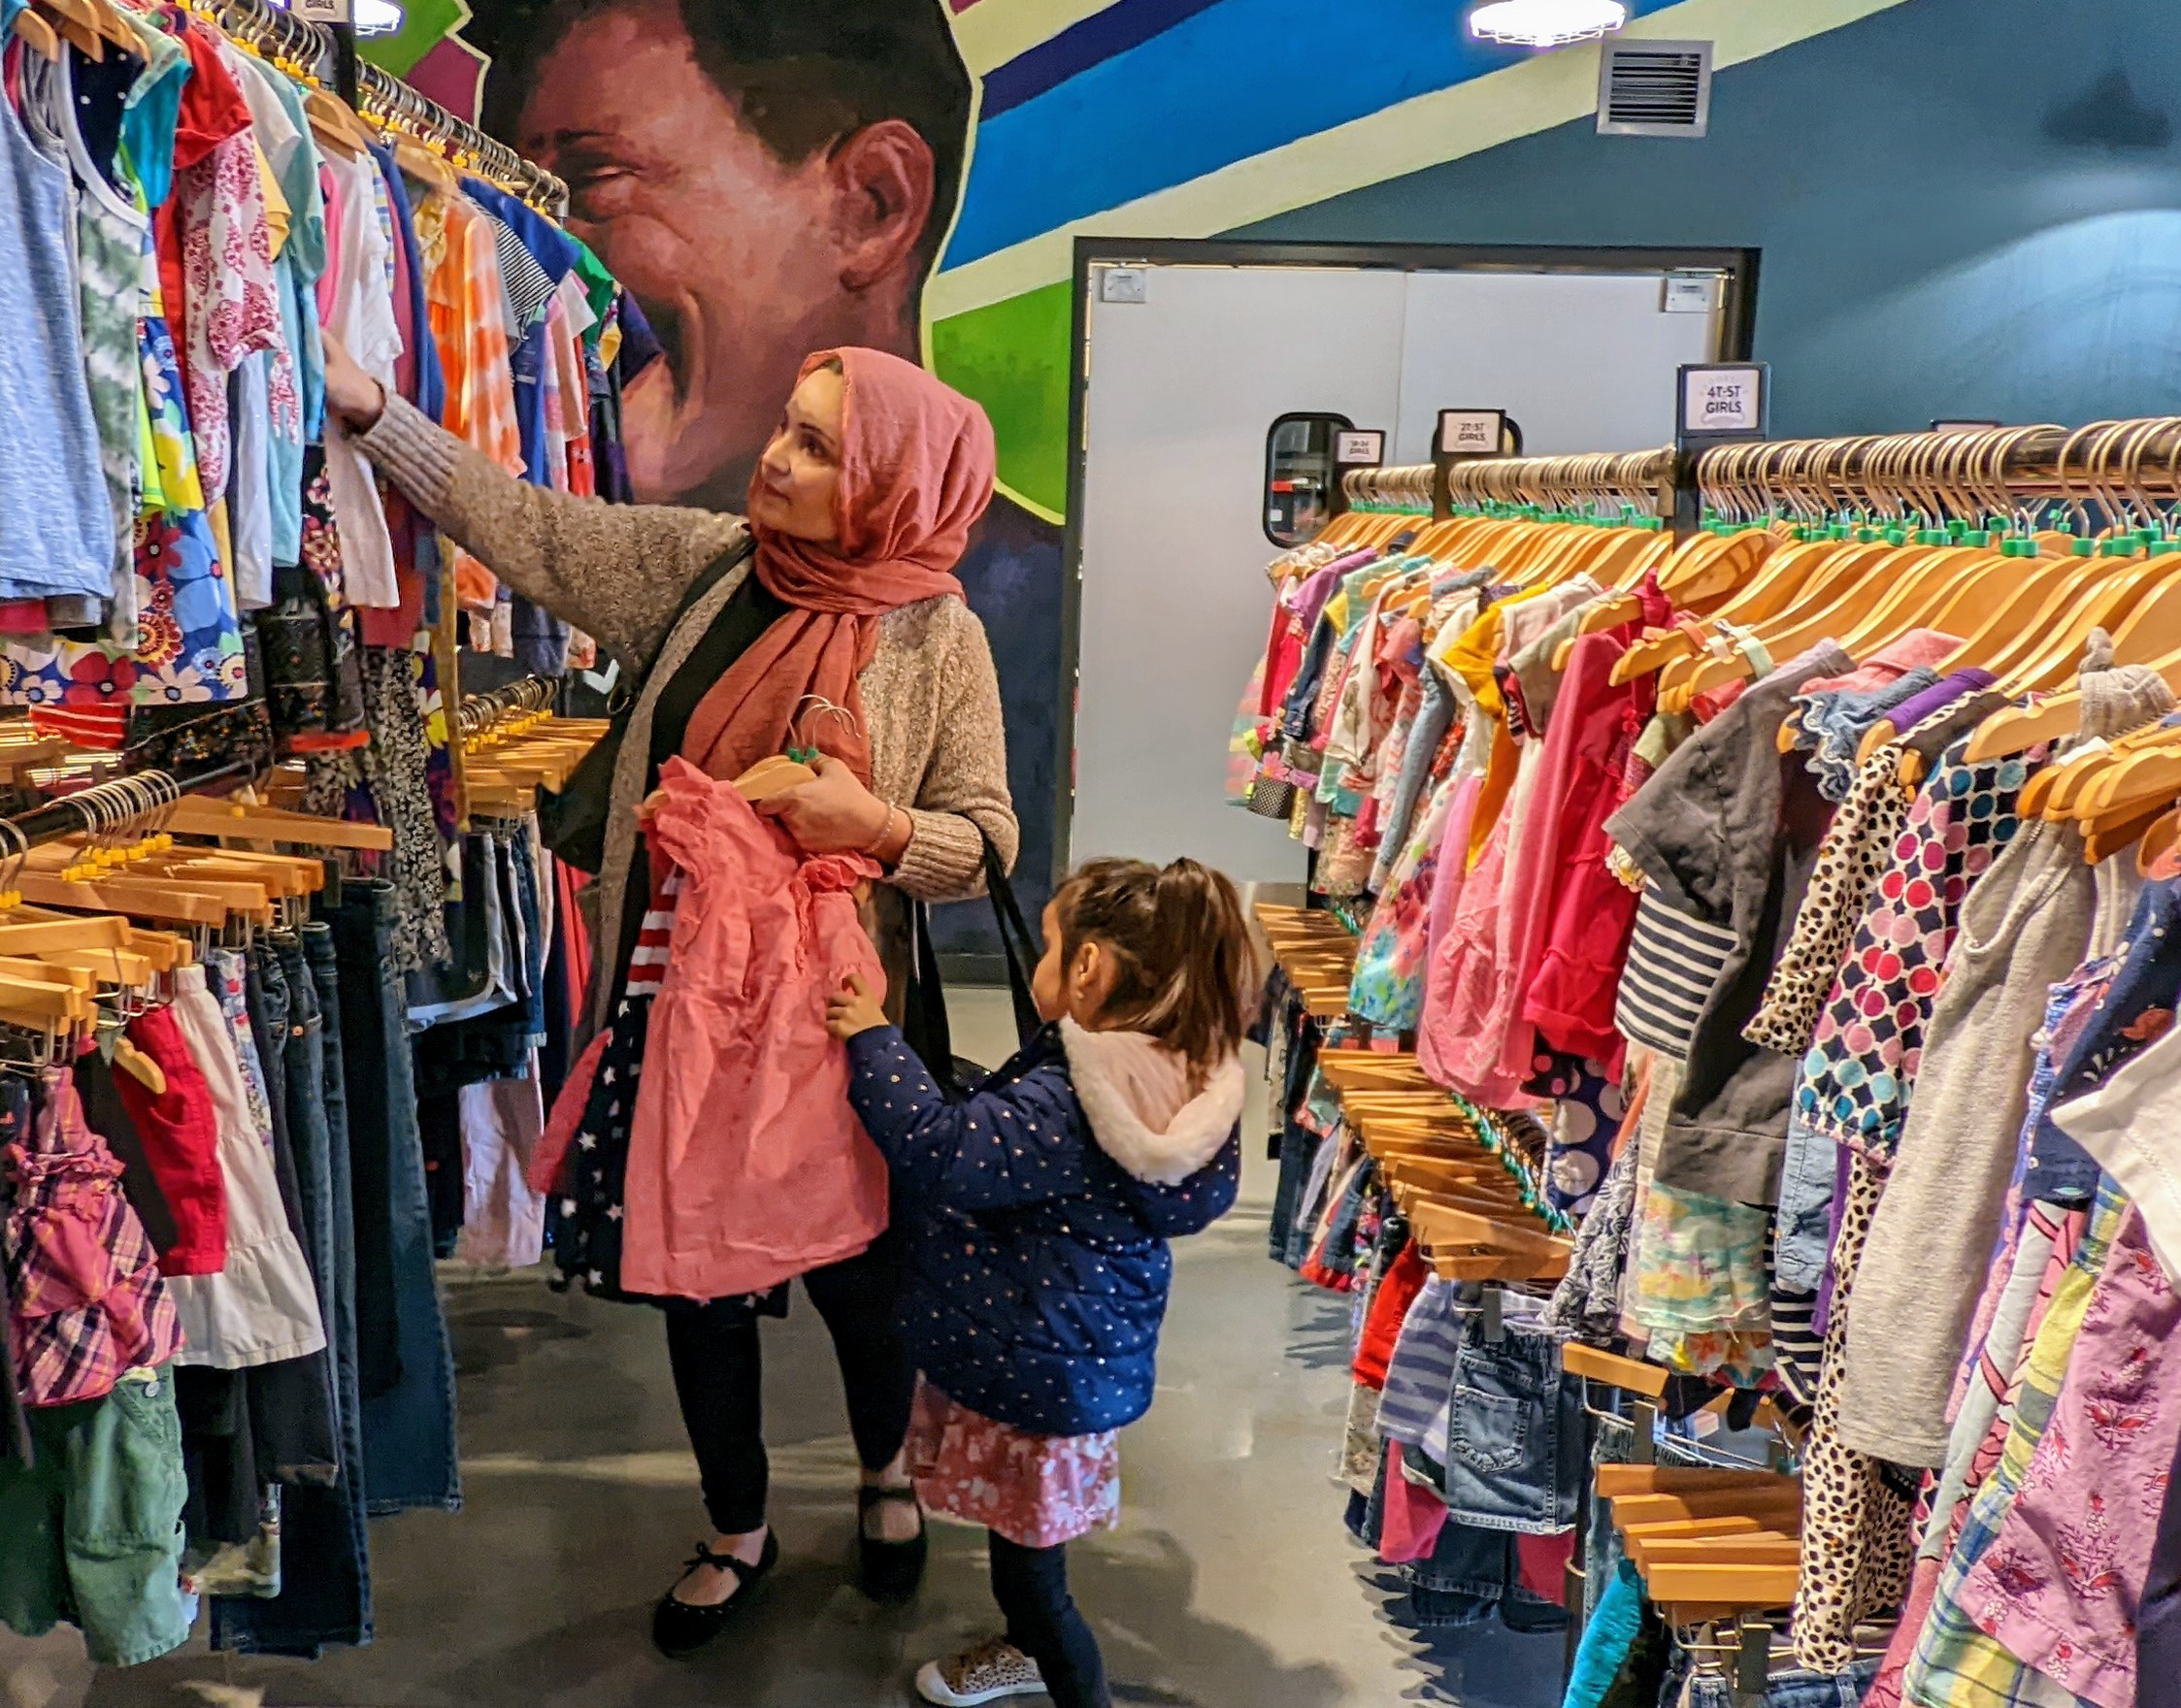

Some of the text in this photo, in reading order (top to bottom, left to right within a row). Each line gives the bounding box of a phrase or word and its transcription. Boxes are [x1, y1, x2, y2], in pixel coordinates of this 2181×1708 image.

[306, 0, 334, 9] GIRLS
[1706, 385, 1741, 398] 4T-5T
[1705, 401, 1742, 413] GIRLS
[1459, 433, 1486, 442] GIRLS
